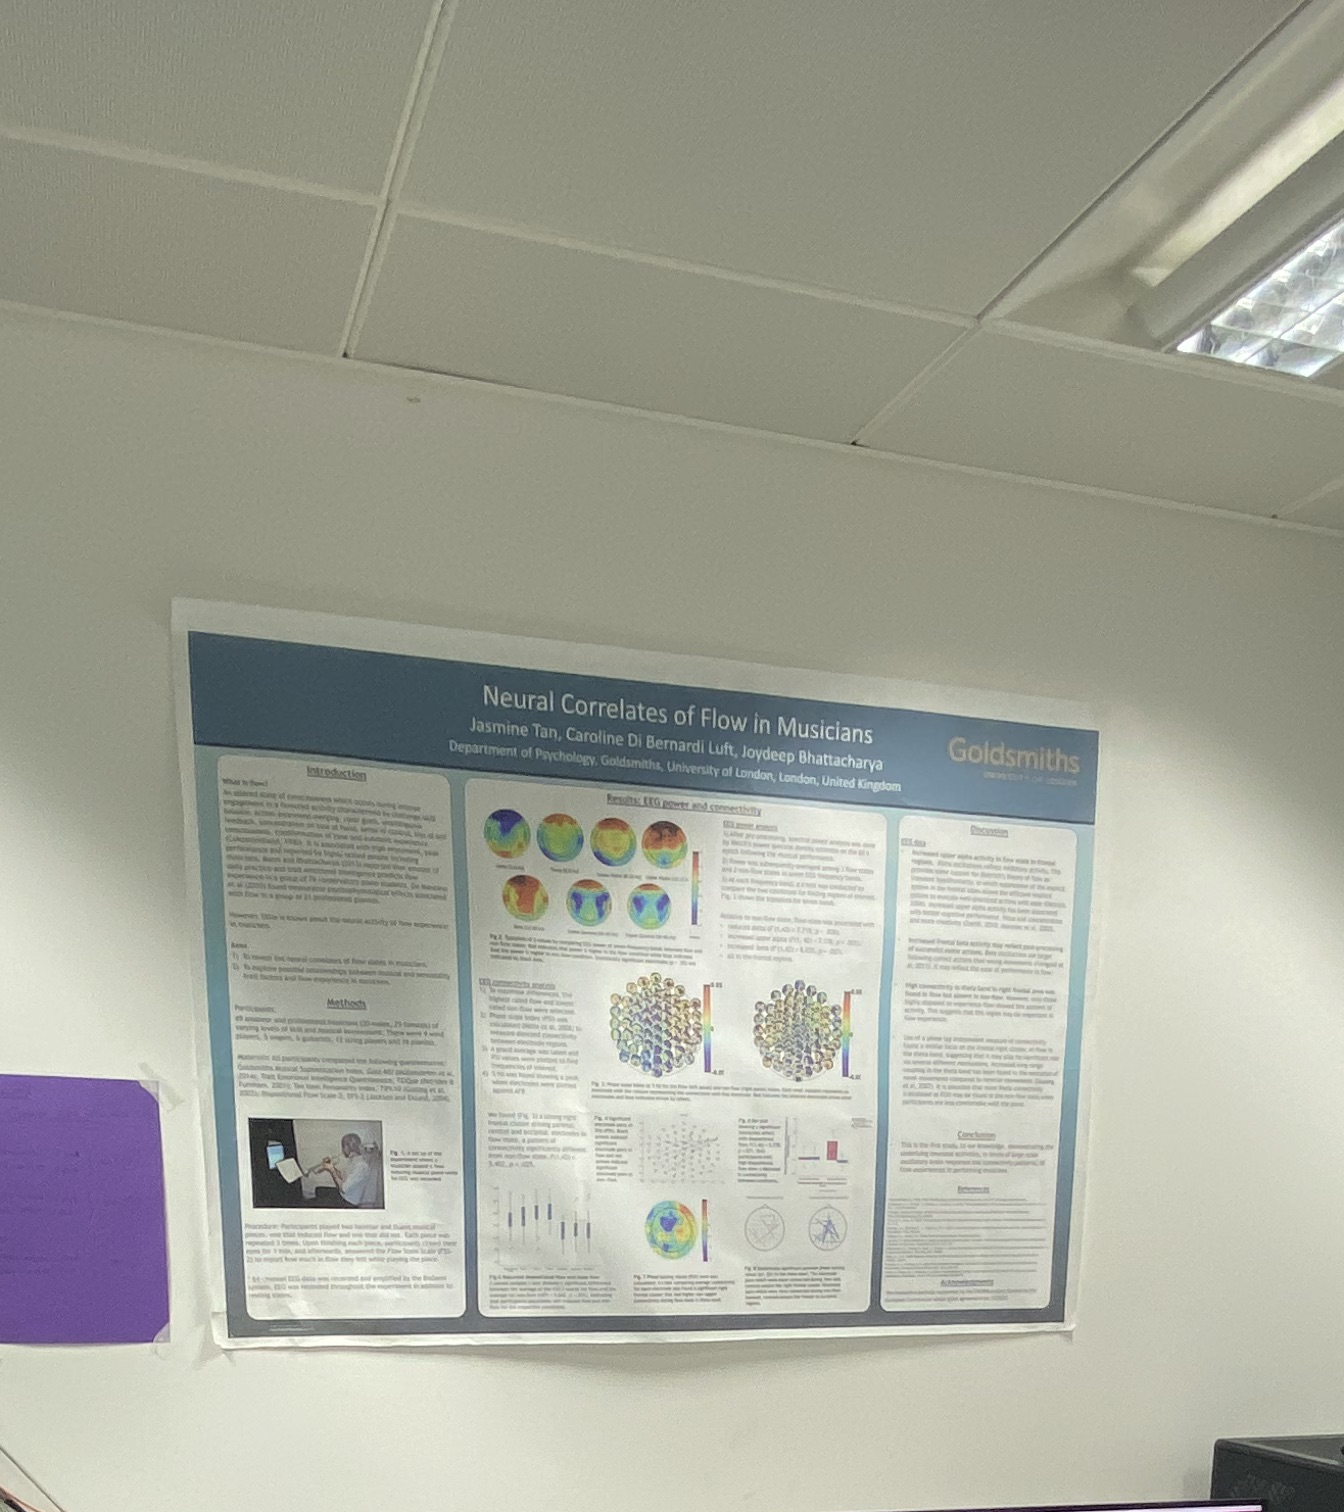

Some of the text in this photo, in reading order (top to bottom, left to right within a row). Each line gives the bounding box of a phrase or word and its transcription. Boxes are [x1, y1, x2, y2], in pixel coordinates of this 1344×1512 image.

[483, 684, 874, 744] Neural Correlates of Flow in Musicians
[470, 717, 884, 772] Jasmine Tan, Caroline Di Bernardi Luft, Joydeep Bhattacharya
[947, 736, 1080, 775] Goldsmiths
[307, 766, 367, 782] Introduction
[448, 739, 902, 793] Department of Psychology, Goldsmiths, University of London, London, United Kingdom
[606, 793, 763, 818] Results: EEG power and connectivity
[327, 998, 367, 1011] Methods
